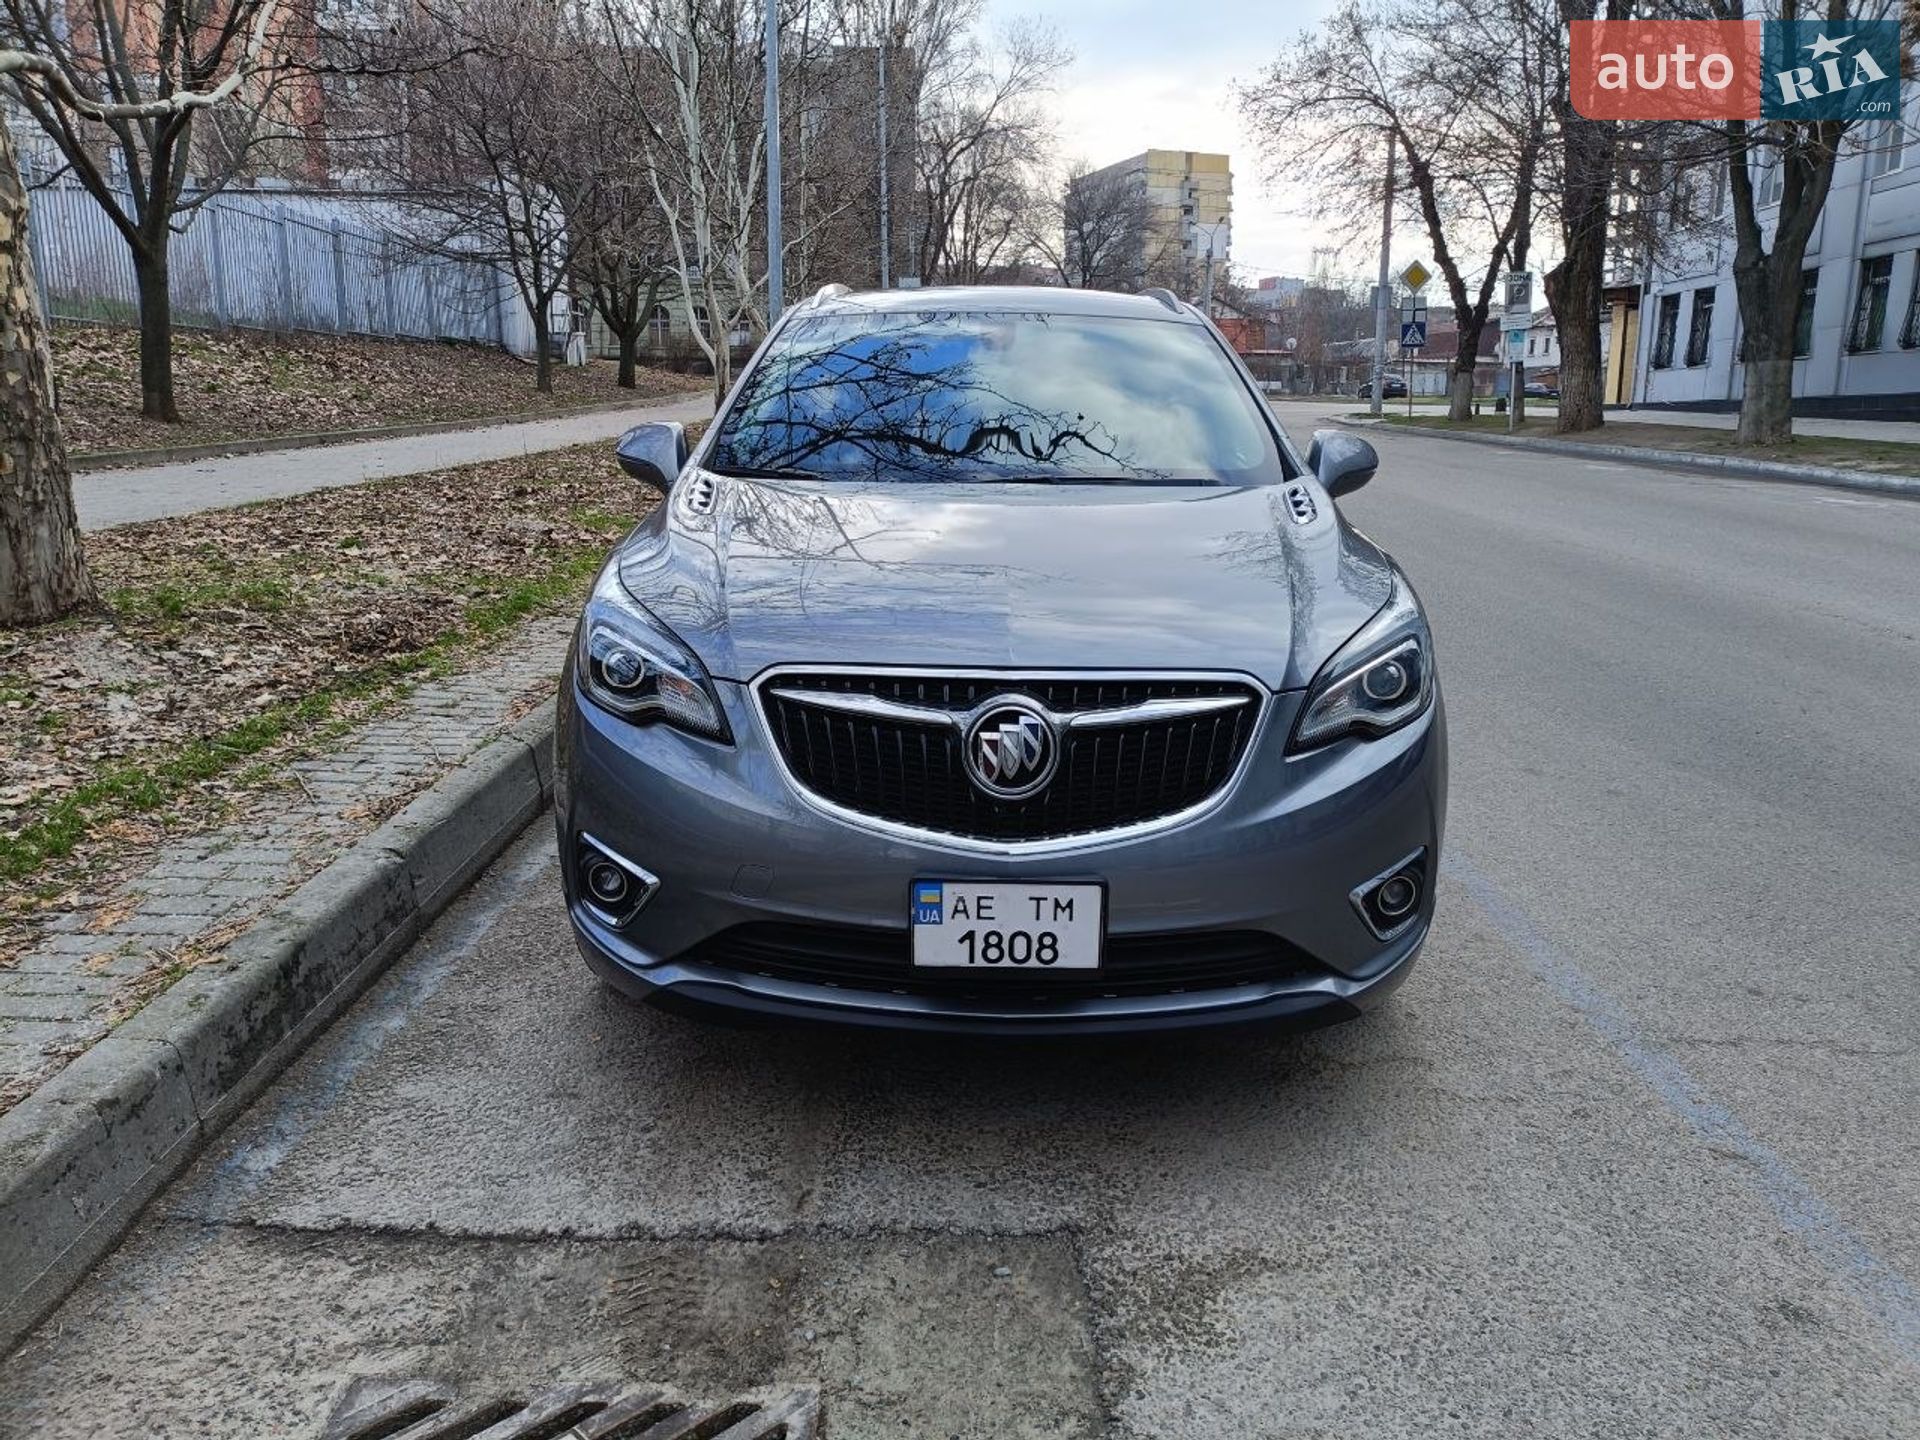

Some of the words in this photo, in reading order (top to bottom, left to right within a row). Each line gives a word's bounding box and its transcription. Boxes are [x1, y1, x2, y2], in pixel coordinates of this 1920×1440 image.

[919, 910, 940, 923] UA
[951, 895, 996, 921] AE
[1028, 896, 1074, 922] TM
[957, 929, 1059, 965] 1808
